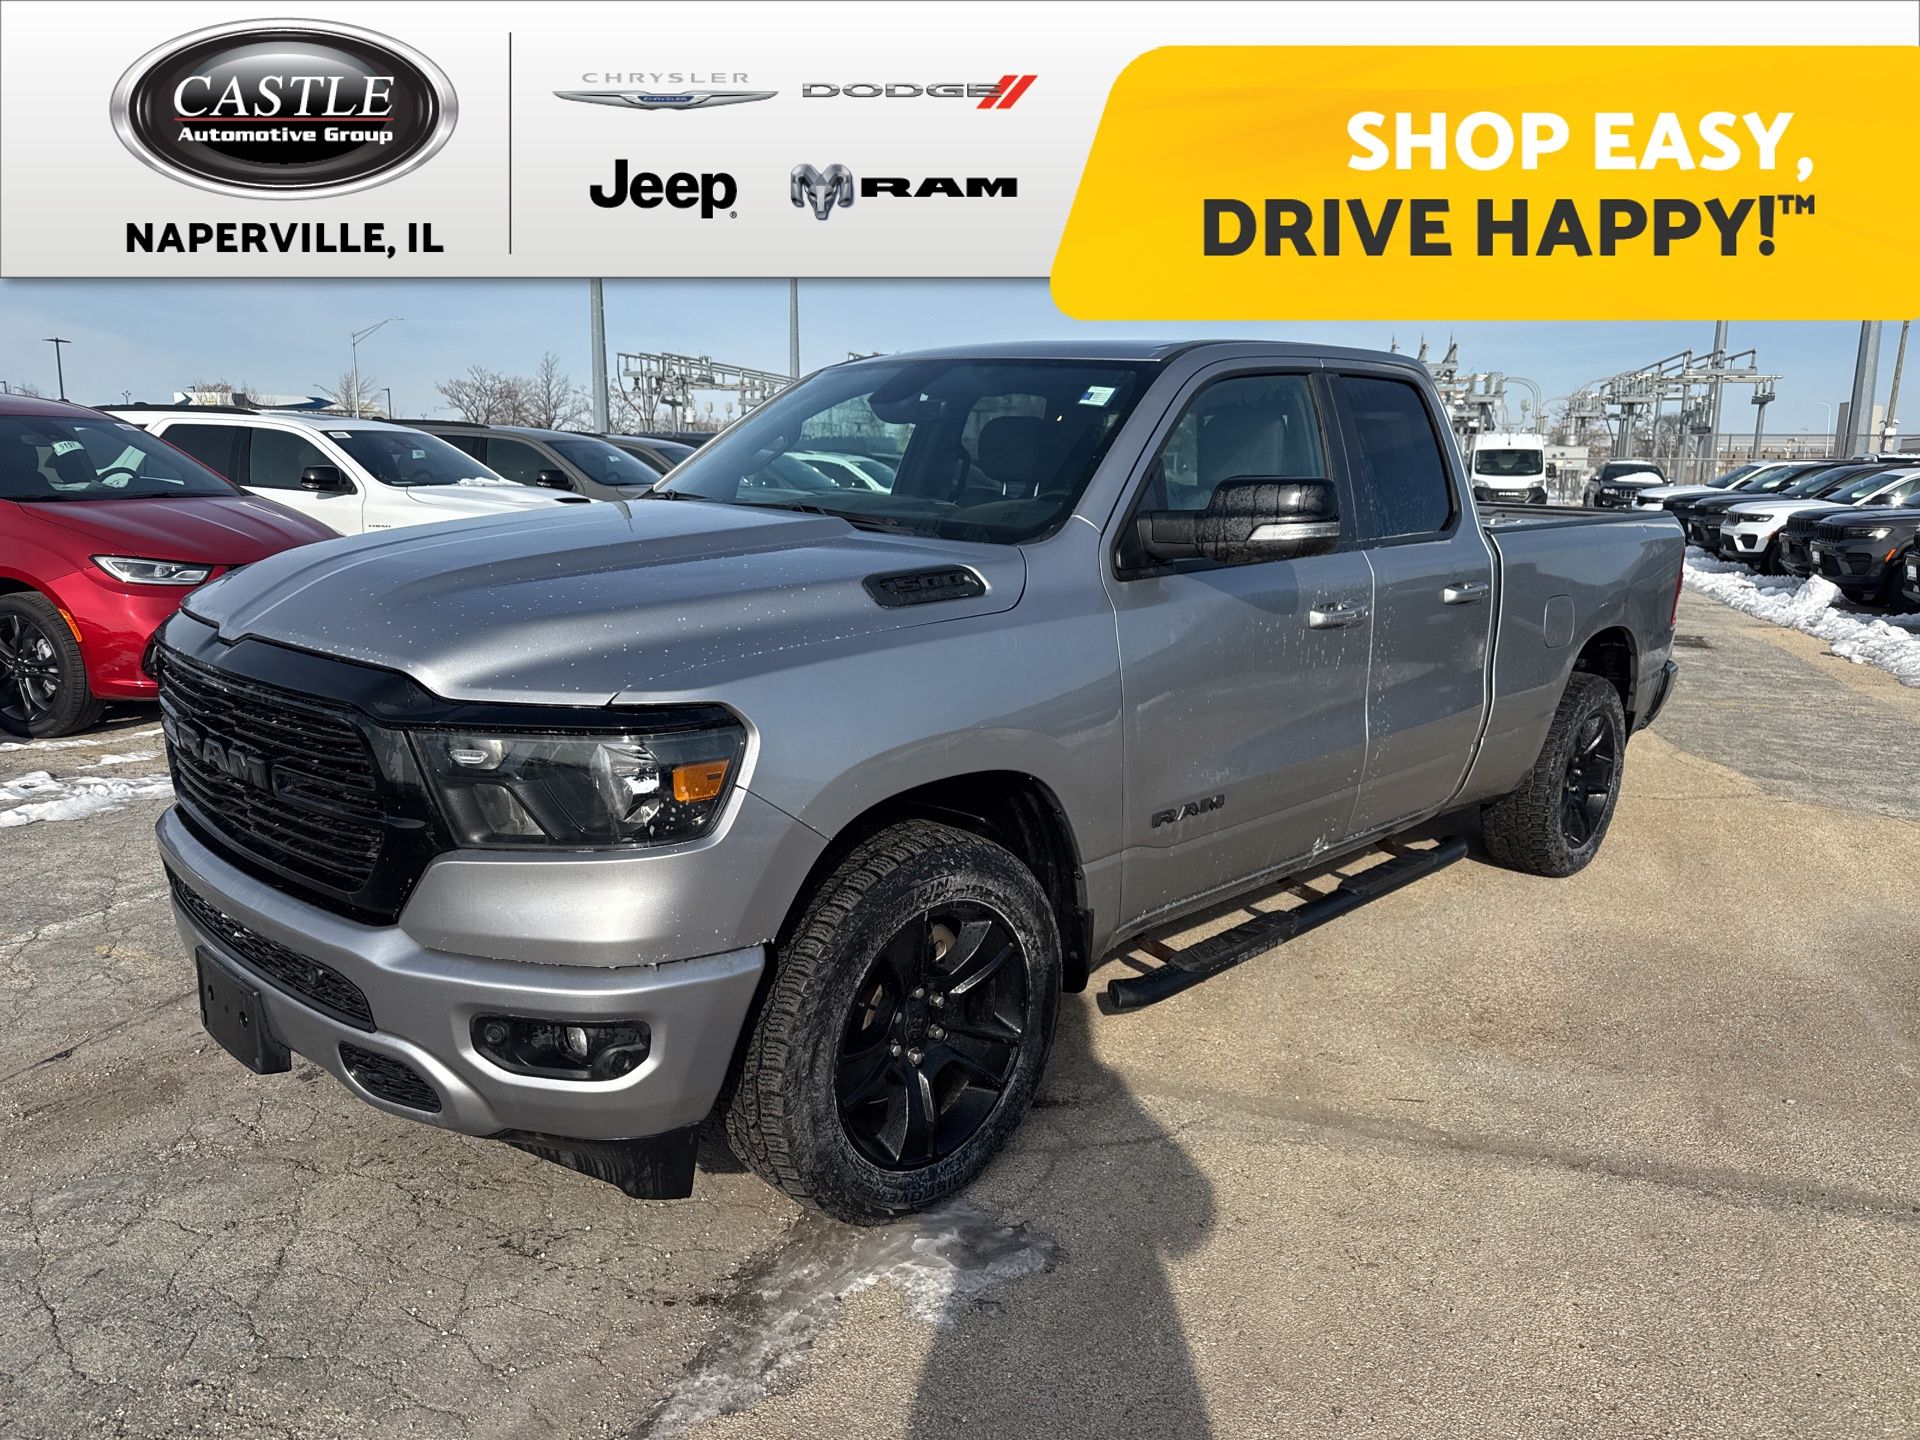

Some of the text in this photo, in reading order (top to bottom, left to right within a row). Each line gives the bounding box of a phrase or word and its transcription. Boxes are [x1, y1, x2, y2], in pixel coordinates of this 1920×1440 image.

[880, 573, 966, 595] 1500
[177, 720, 267, 793] RAM
[1151, 793, 1226, 829] RAM
